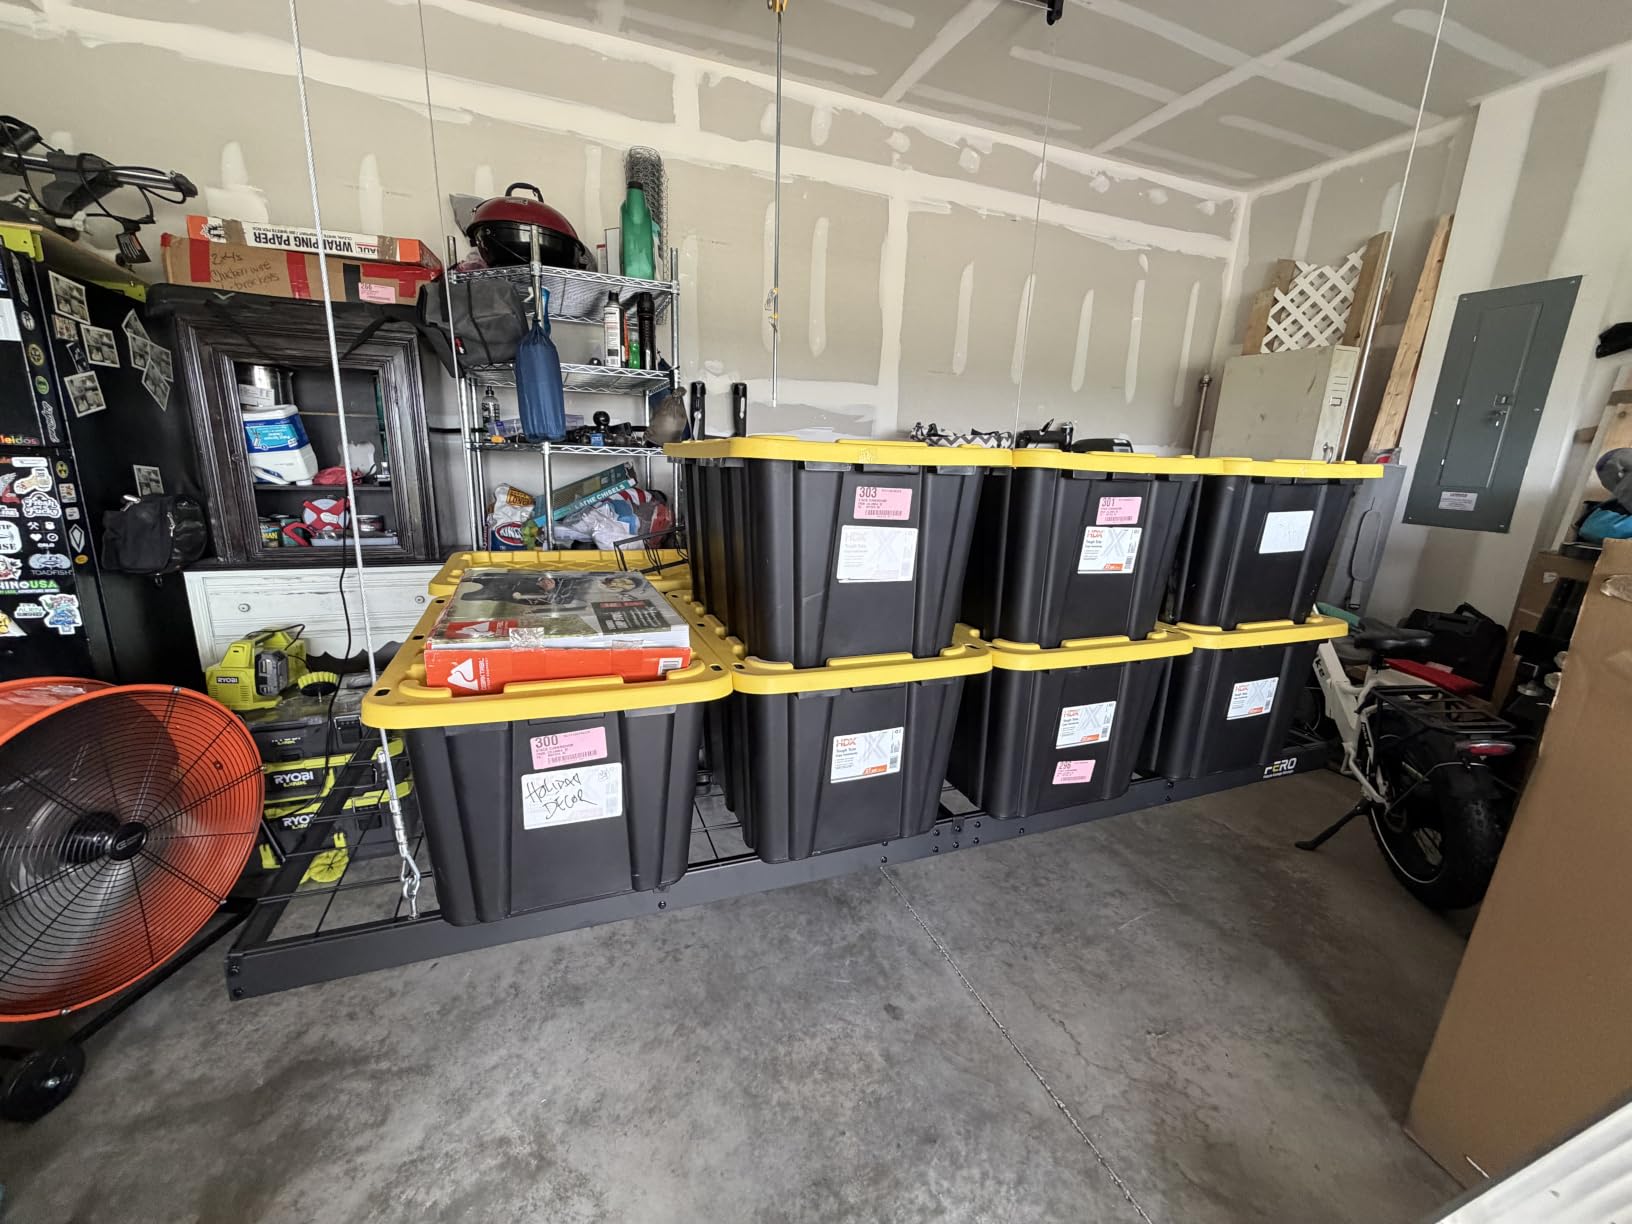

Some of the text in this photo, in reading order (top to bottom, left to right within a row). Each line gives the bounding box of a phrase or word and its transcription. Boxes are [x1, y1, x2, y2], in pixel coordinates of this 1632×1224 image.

[253, 231, 291, 246] PAPER
[574, 483, 626, 510] LATHE CHISELS
[859, 486, 877, 498] 303
[535, 734, 559, 748] 300
[836, 737, 857, 748] HDX
[273, 770, 314, 785] RYOBI
